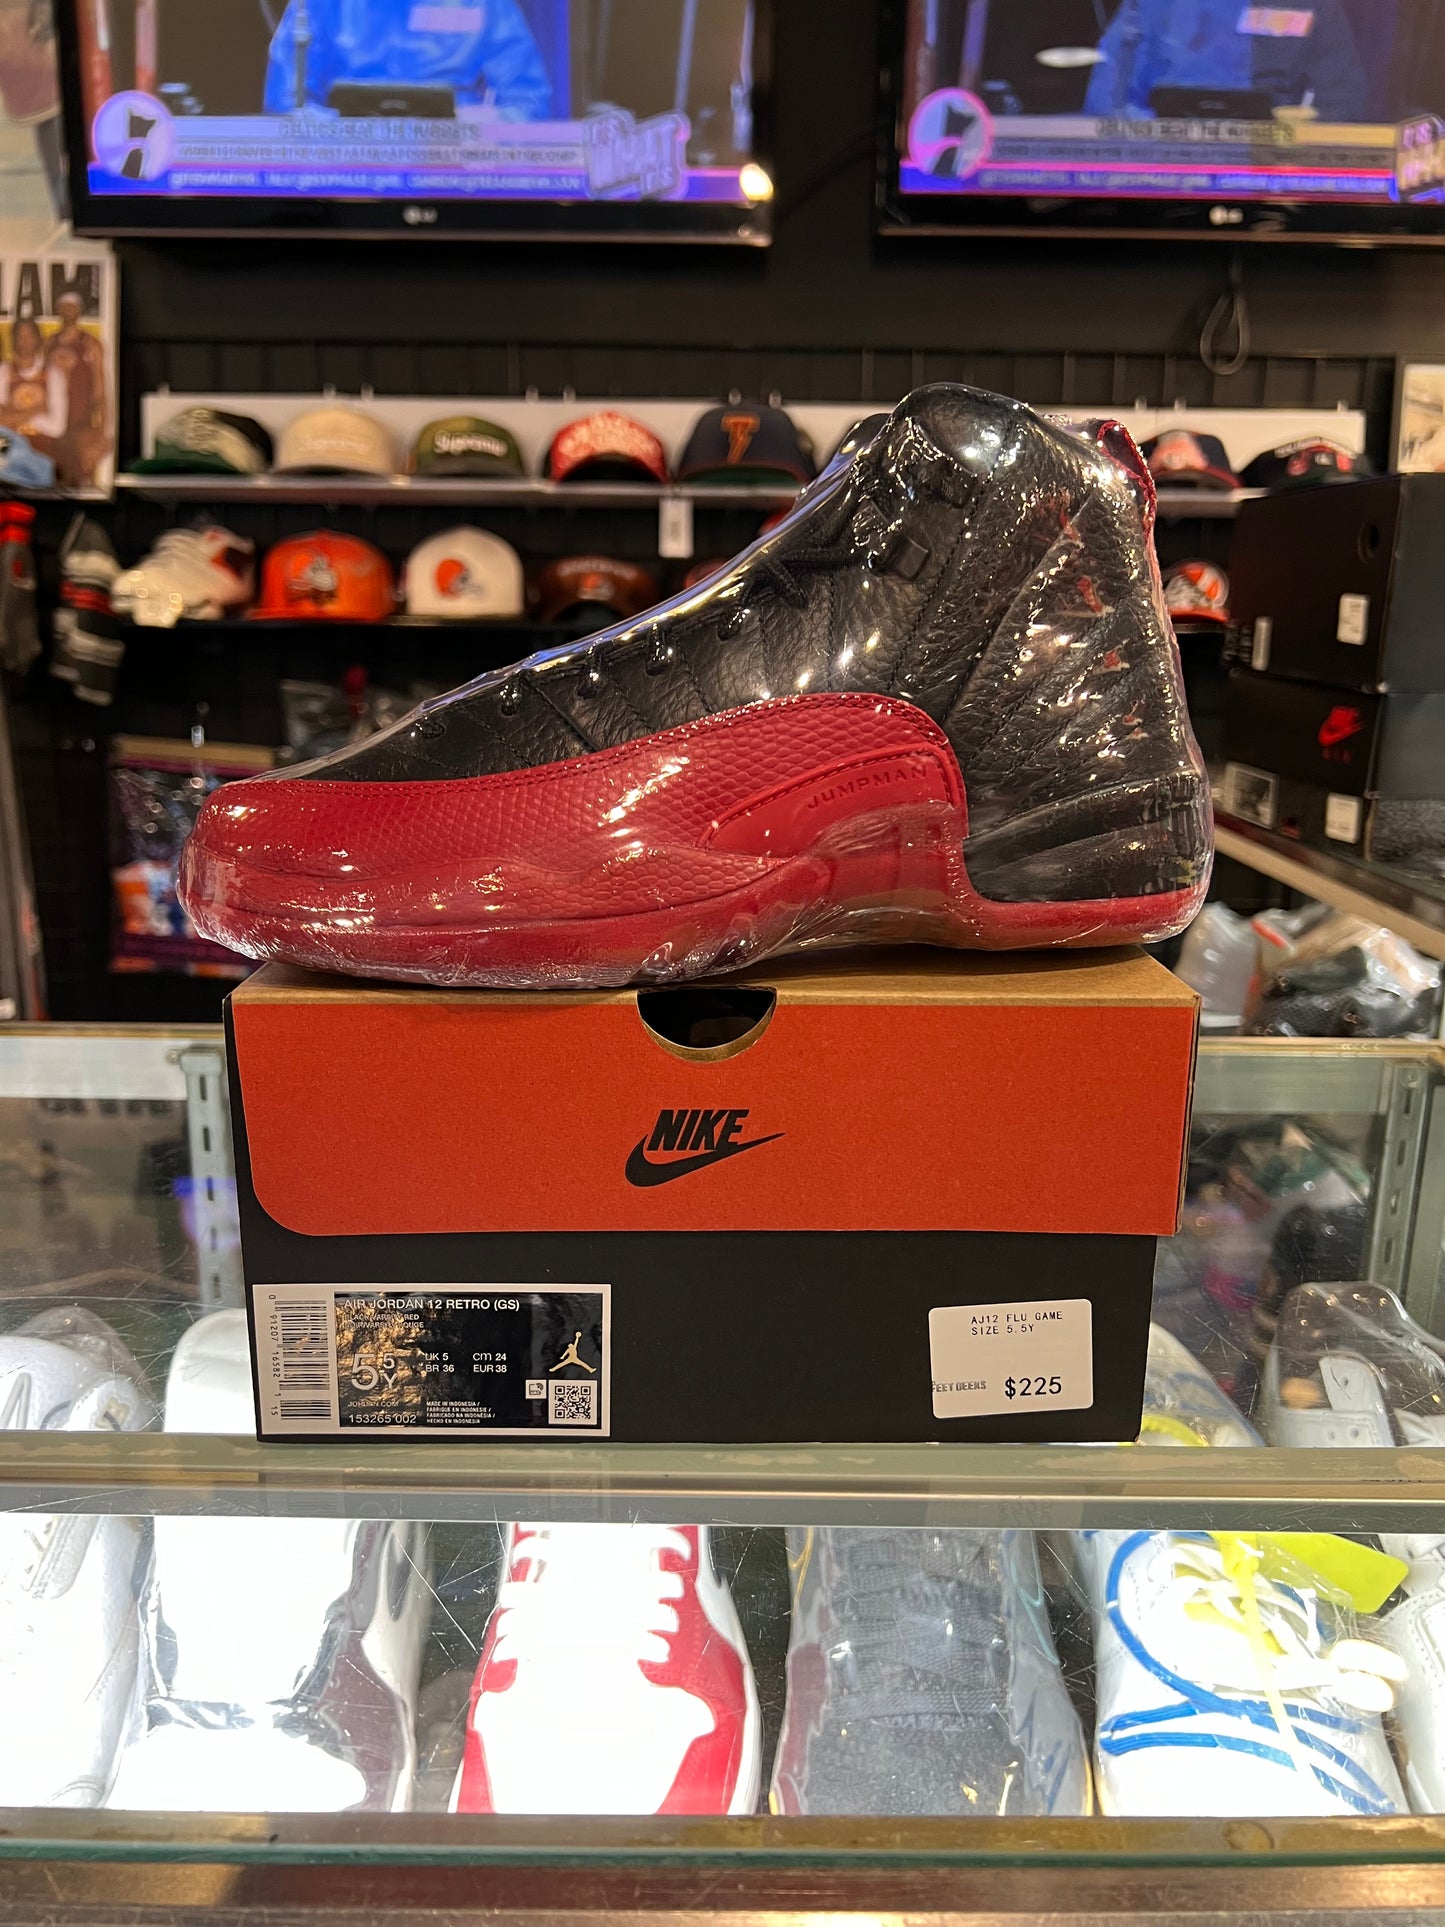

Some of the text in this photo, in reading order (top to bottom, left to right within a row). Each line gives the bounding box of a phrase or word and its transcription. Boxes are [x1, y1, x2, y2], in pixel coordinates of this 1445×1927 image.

[0, 262, 99, 316] AM
[807, 765, 928, 809] JUMPMAN
[647, 1109, 750, 1151] NIKE
[344, 1299, 520, 1311] AIR JORDAN 12 RETRO (GS)
[270, 1314, 279, 1342] 91207
[971, 1311, 1063, 1325] AJ12 FLU GAME
[971, 1323, 1035, 1336] SIZE 5.5Y
[272, 1351, 281, 1378] 16582
[425, 1352, 439, 1361] UK
[442, 1352, 449, 1361] 5
[495, 1352, 507, 1361] 24
[351, 1352, 395, 1391] 5 5
[425, 1364, 508, 1373] BR 36 EUR 38
[383, 1373, 397, 1389] Y
[1004, 1376, 1062, 1400] $225
[348, 1413, 417, 1424] 153265 002
